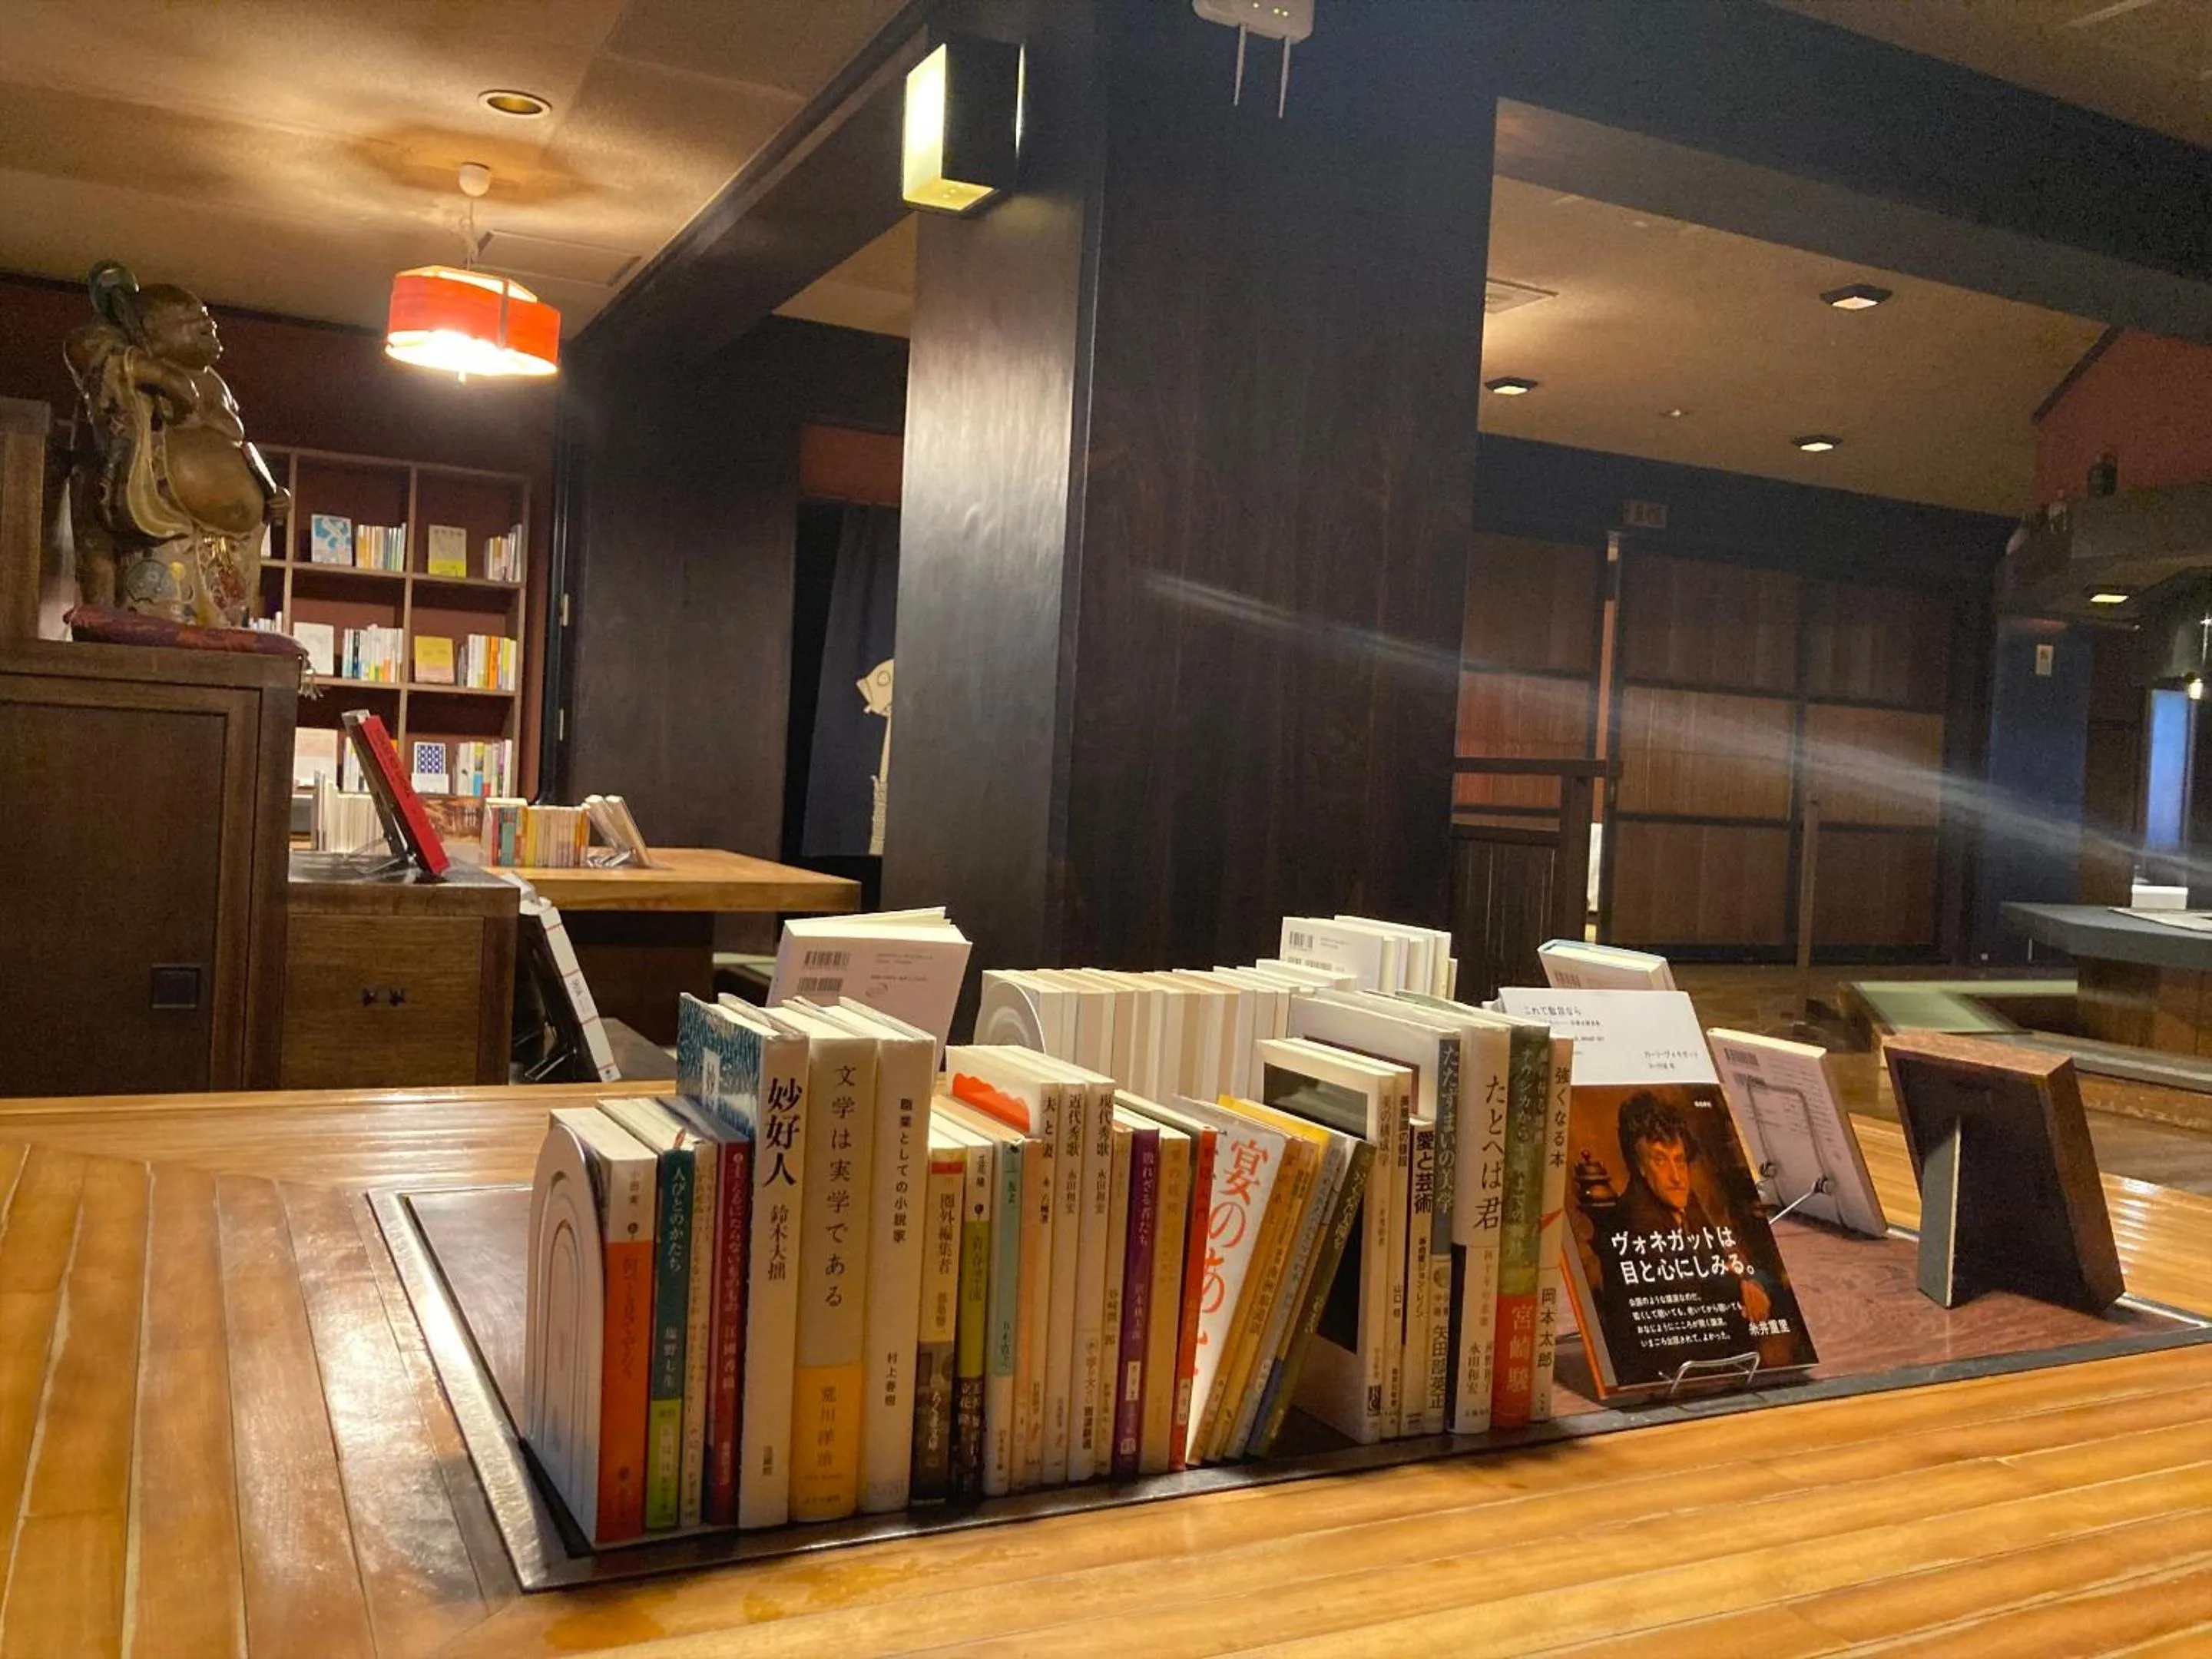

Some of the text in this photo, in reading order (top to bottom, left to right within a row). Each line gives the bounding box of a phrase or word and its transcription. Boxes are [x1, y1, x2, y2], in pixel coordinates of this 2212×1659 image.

[763, 1077, 803, 1187] 妙好人
[1473, 1075, 1507, 1230] たとへば君
[824, 1065, 857, 1306] 文学は実学である
[1611, 1226, 1737, 1257] ヴォネガットは
[1620, 1253, 1755, 1285] 目と心にしみる。
[1536, 1286, 1557, 1369] 岡本太郎
[1748, 1319, 1791, 1337] 糸井重里
